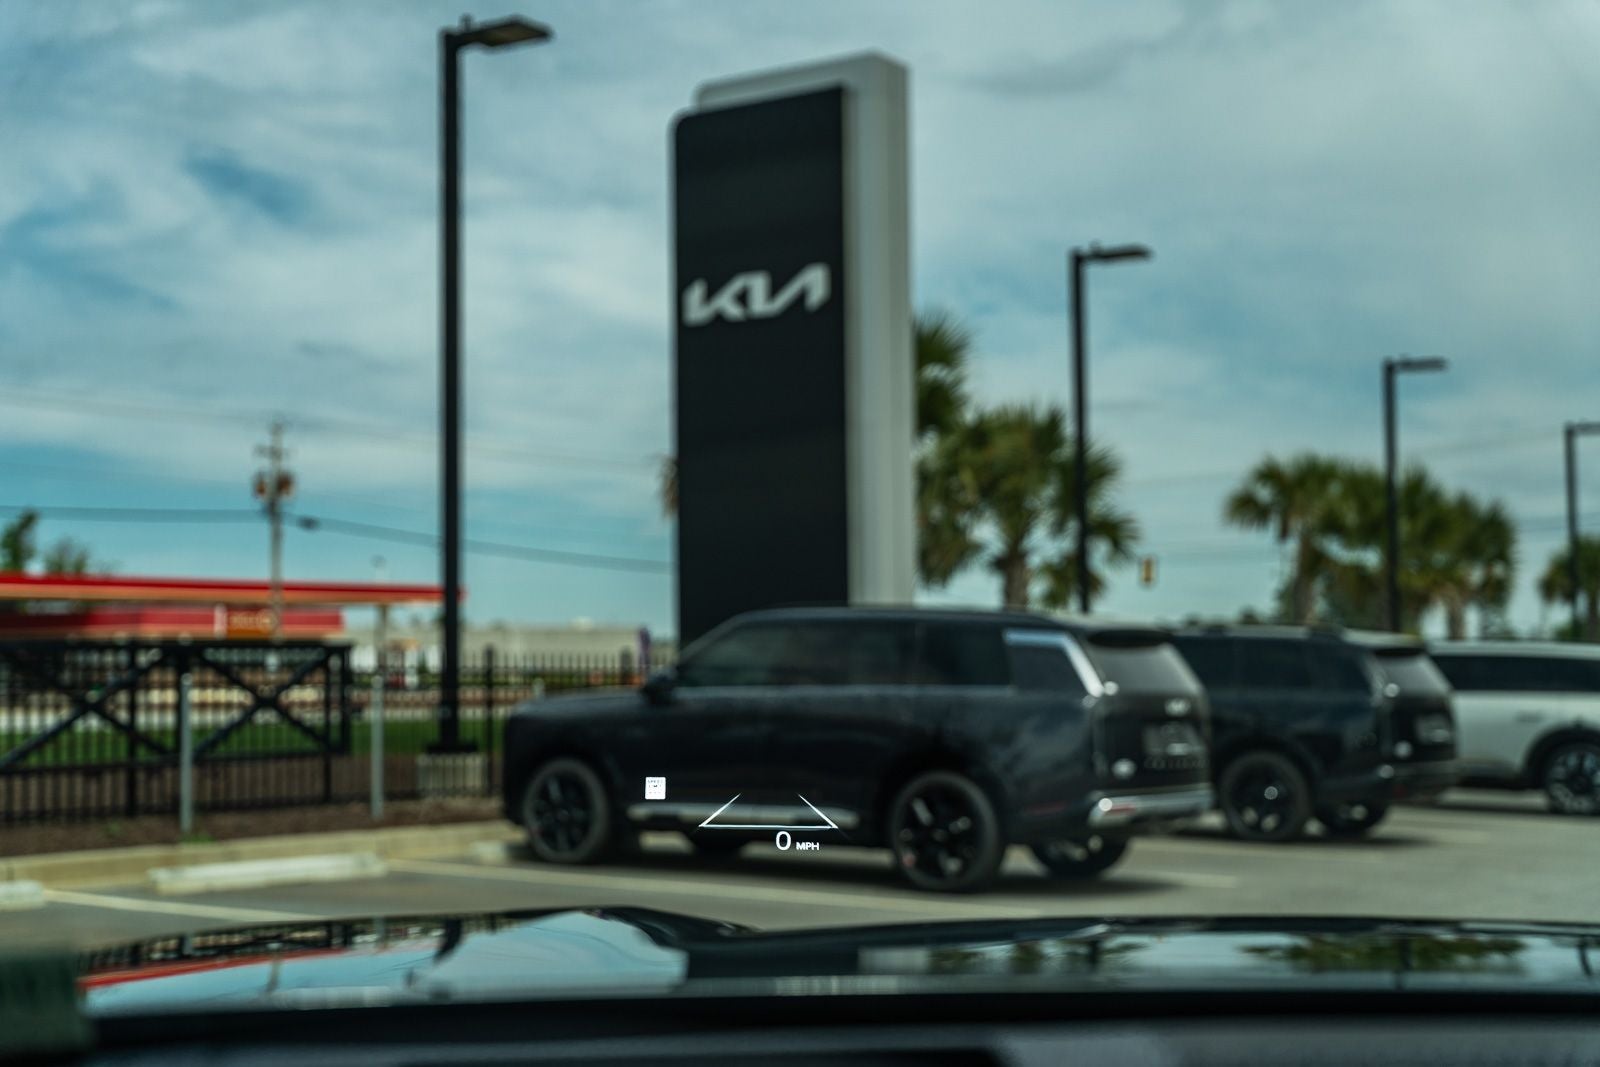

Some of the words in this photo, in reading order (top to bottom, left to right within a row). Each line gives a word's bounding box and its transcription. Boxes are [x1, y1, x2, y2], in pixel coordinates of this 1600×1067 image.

[684, 264, 830, 325] KIA
[776, 831, 791, 850] 0
[796, 842, 819, 850] MPH
